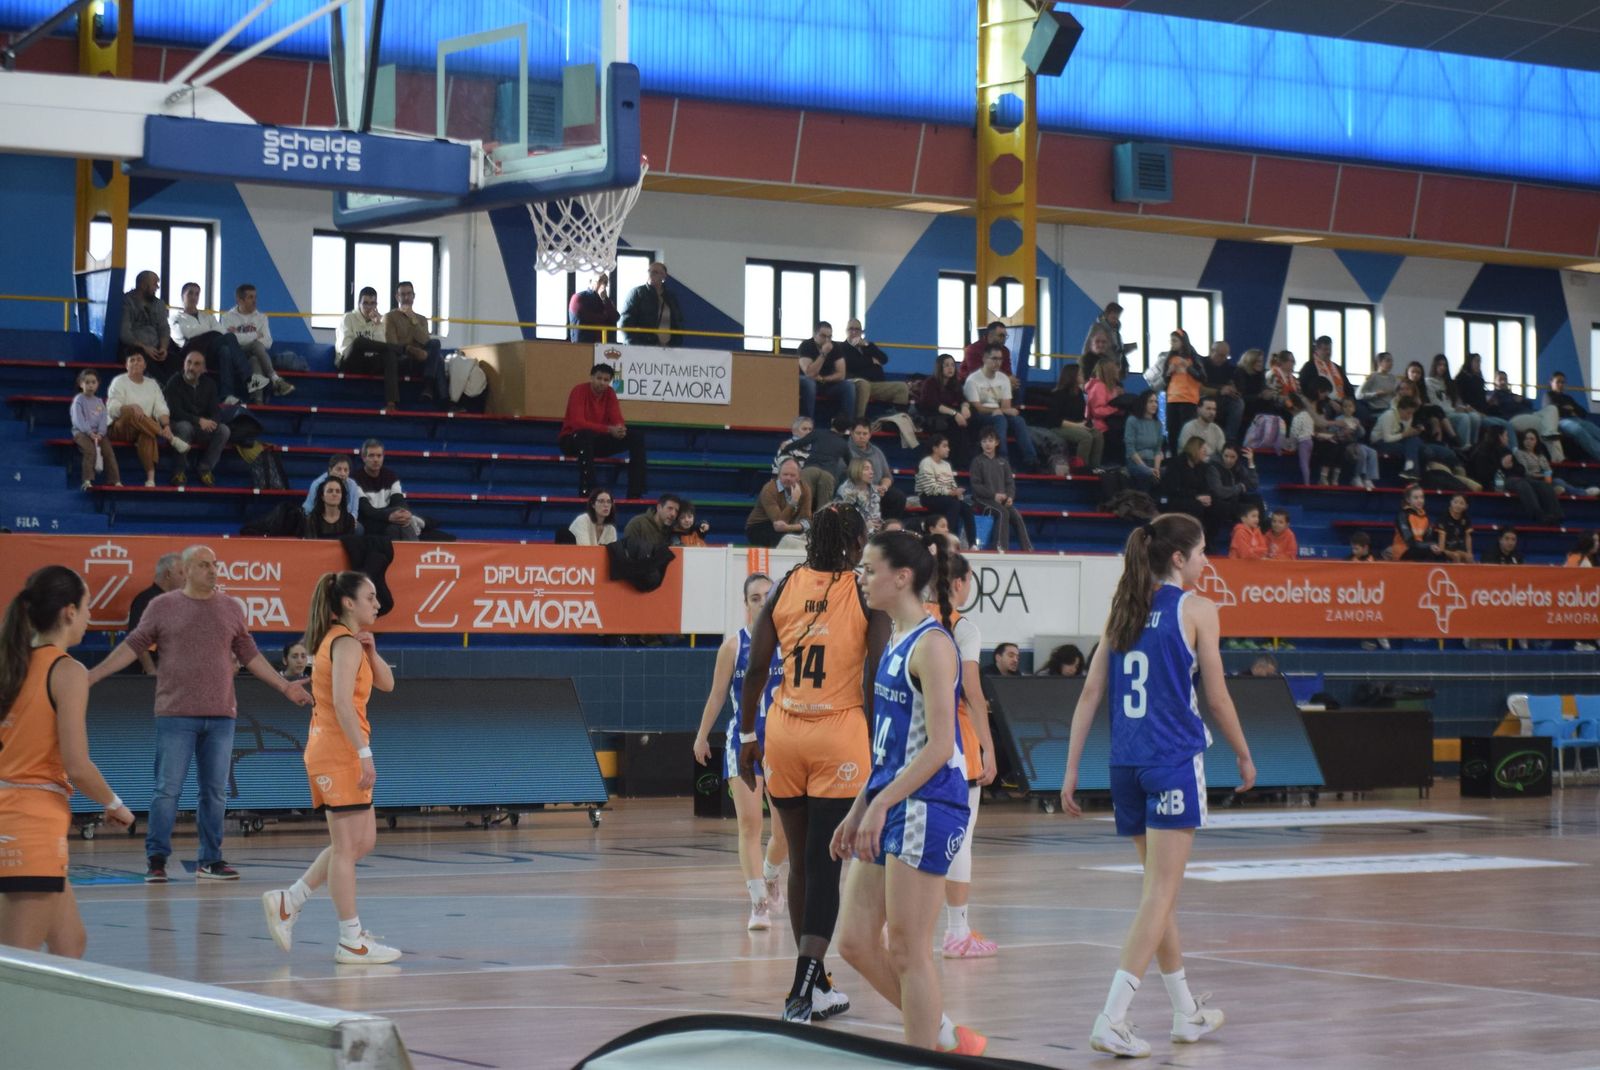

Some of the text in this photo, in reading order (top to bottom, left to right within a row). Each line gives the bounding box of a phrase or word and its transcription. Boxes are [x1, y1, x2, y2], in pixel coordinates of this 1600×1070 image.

[264, 129, 361, 154] Schelde
[263, 147, 361, 171] Sports
[628, 361, 726, 379] AYUNTAMIENTO
[627, 378, 725, 399] DE ZAMORA
[1242, 579, 1385, 604] recoletas salud
[1471, 583, 1600, 608] recoletas salud
[473, 599, 603, 629] ZAMORA
[1326, 609, 1384, 622] ZAMORA
[1546, 612, 1600, 624] ZAMORA
[793, 644, 827, 689] 14
[1123, 650, 1149, 719] 3
